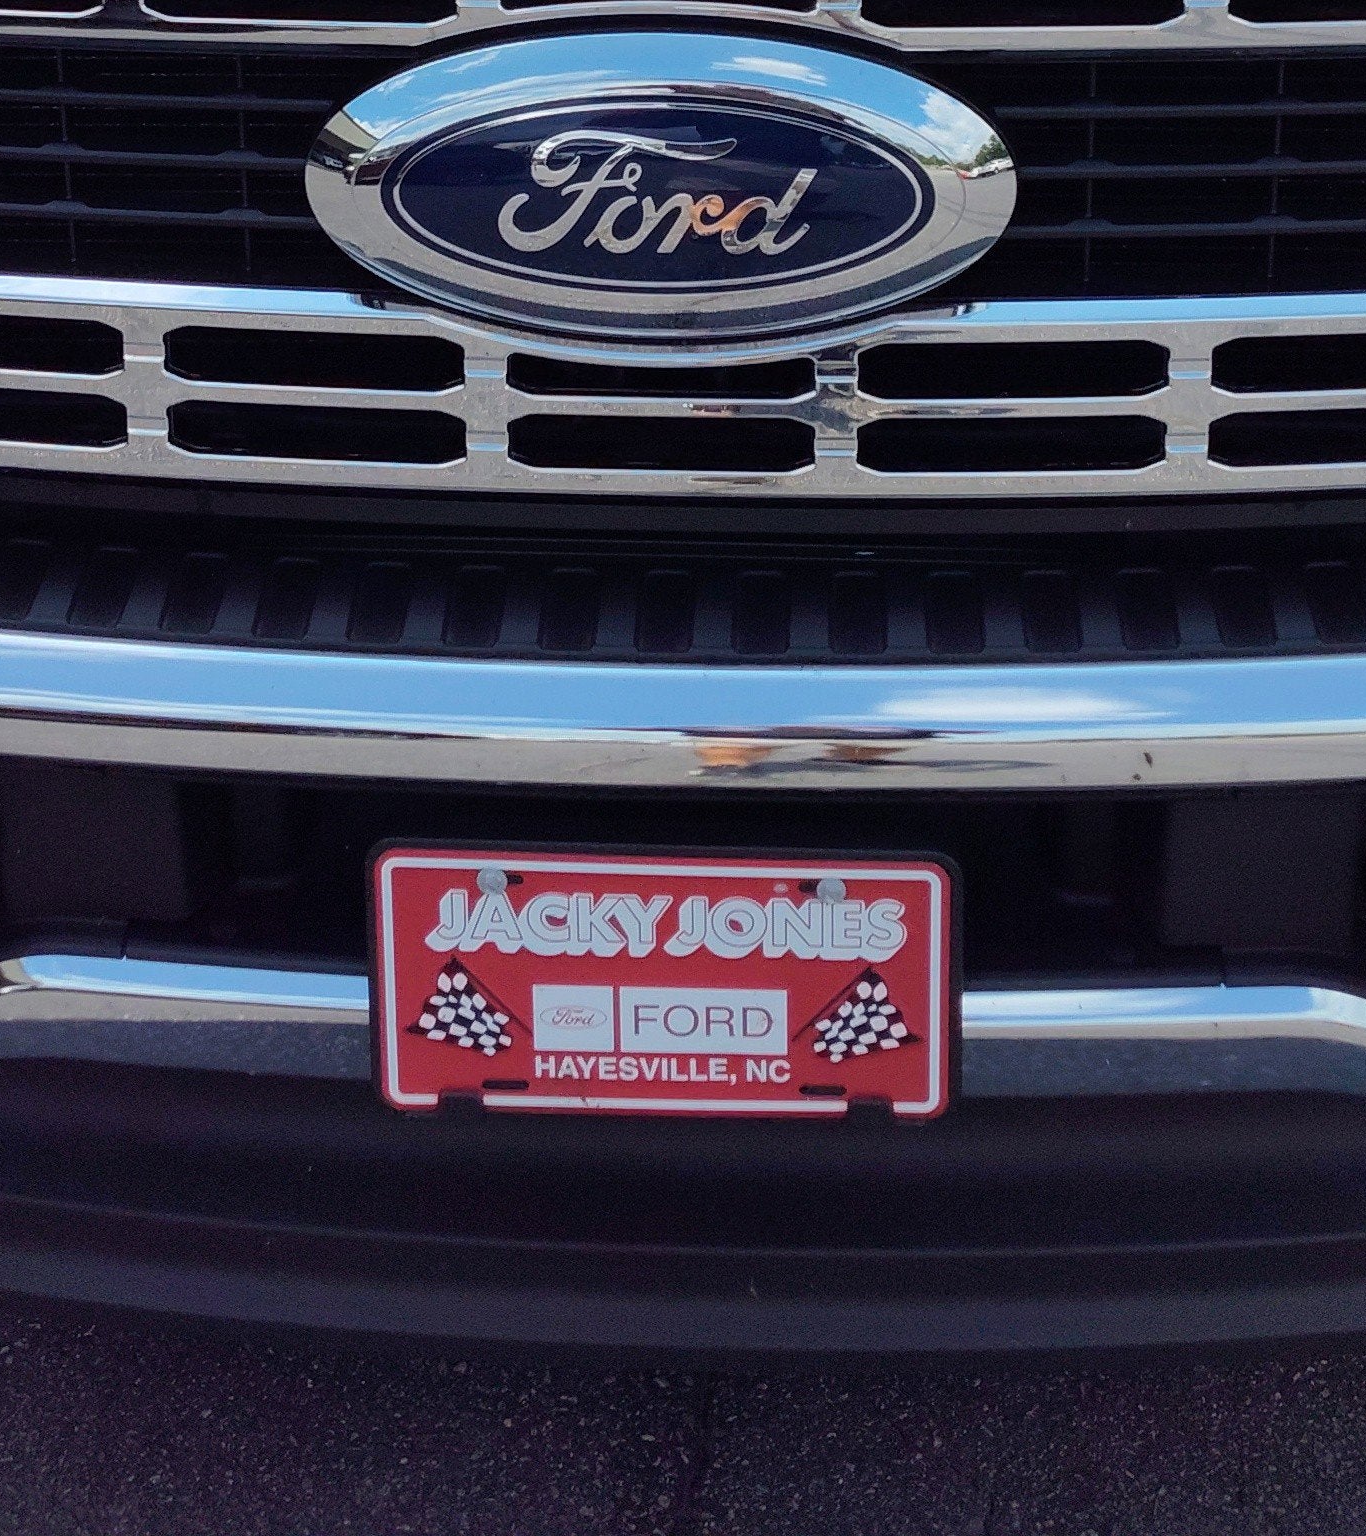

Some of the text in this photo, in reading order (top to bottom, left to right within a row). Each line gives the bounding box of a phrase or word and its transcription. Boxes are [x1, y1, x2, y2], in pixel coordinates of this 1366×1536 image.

[497, 129, 812, 255] Ford
[425, 888, 908, 963] JACKY JONES
[551, 1008, 595, 1026] Ford
[633, 1004, 774, 1039] FORD
[535, 1055, 792, 1086] HAYESVILLE, NC
